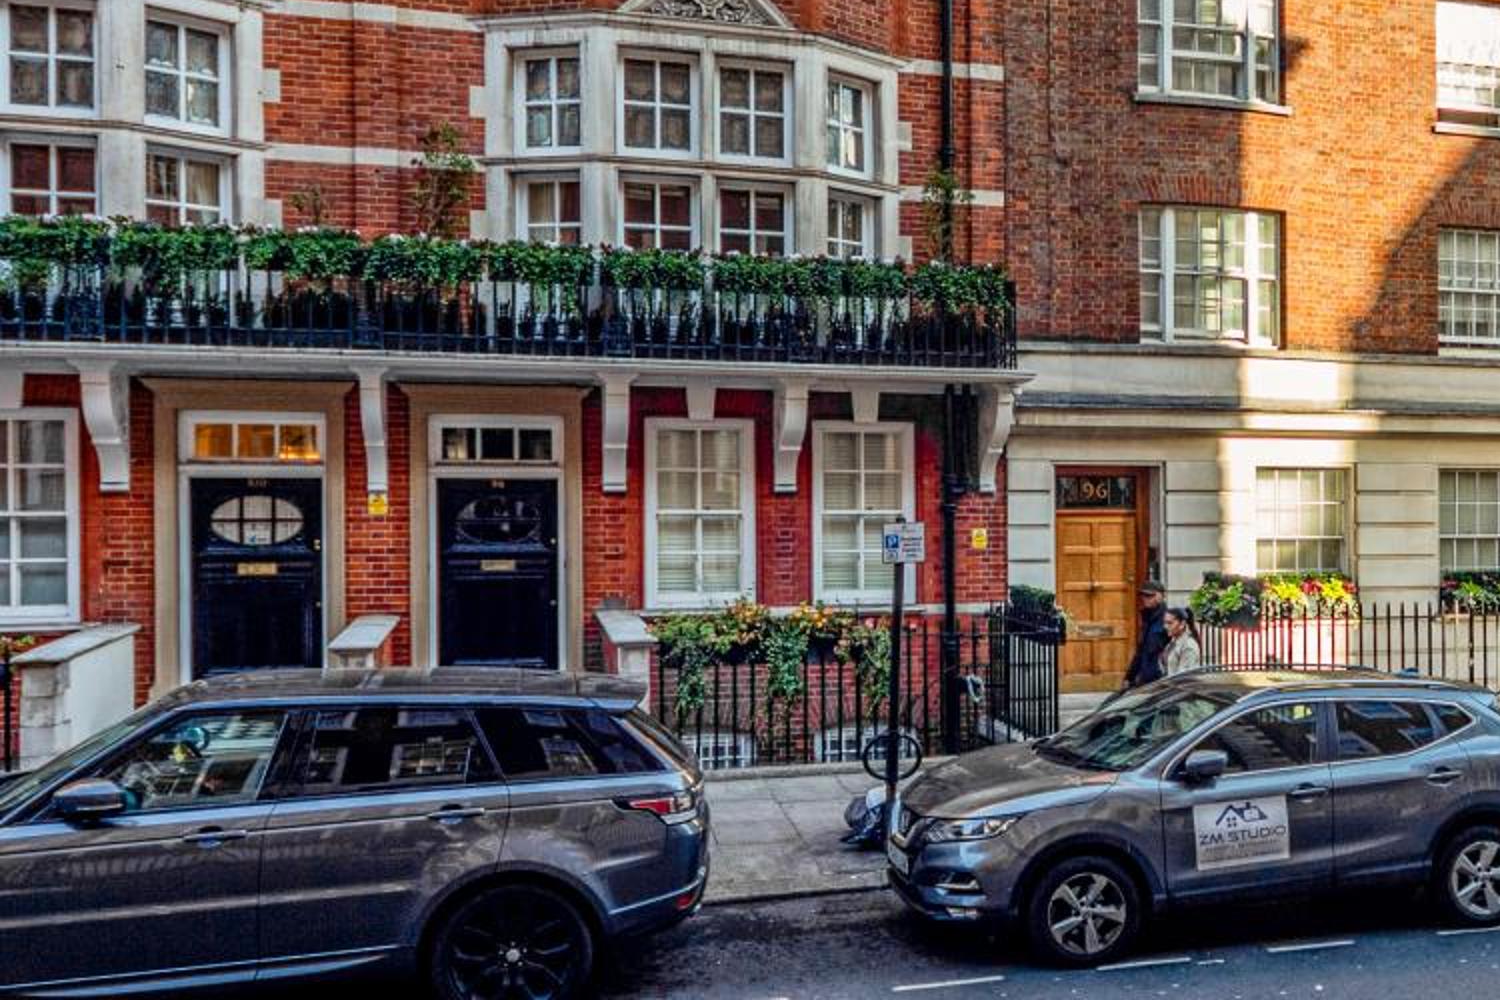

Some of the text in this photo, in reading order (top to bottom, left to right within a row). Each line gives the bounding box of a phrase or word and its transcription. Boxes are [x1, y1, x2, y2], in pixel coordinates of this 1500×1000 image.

[1083, 482, 1107, 499] 96
[1200, 832, 1223, 846] ZM
[1227, 824, 1286, 842] STUDIO
